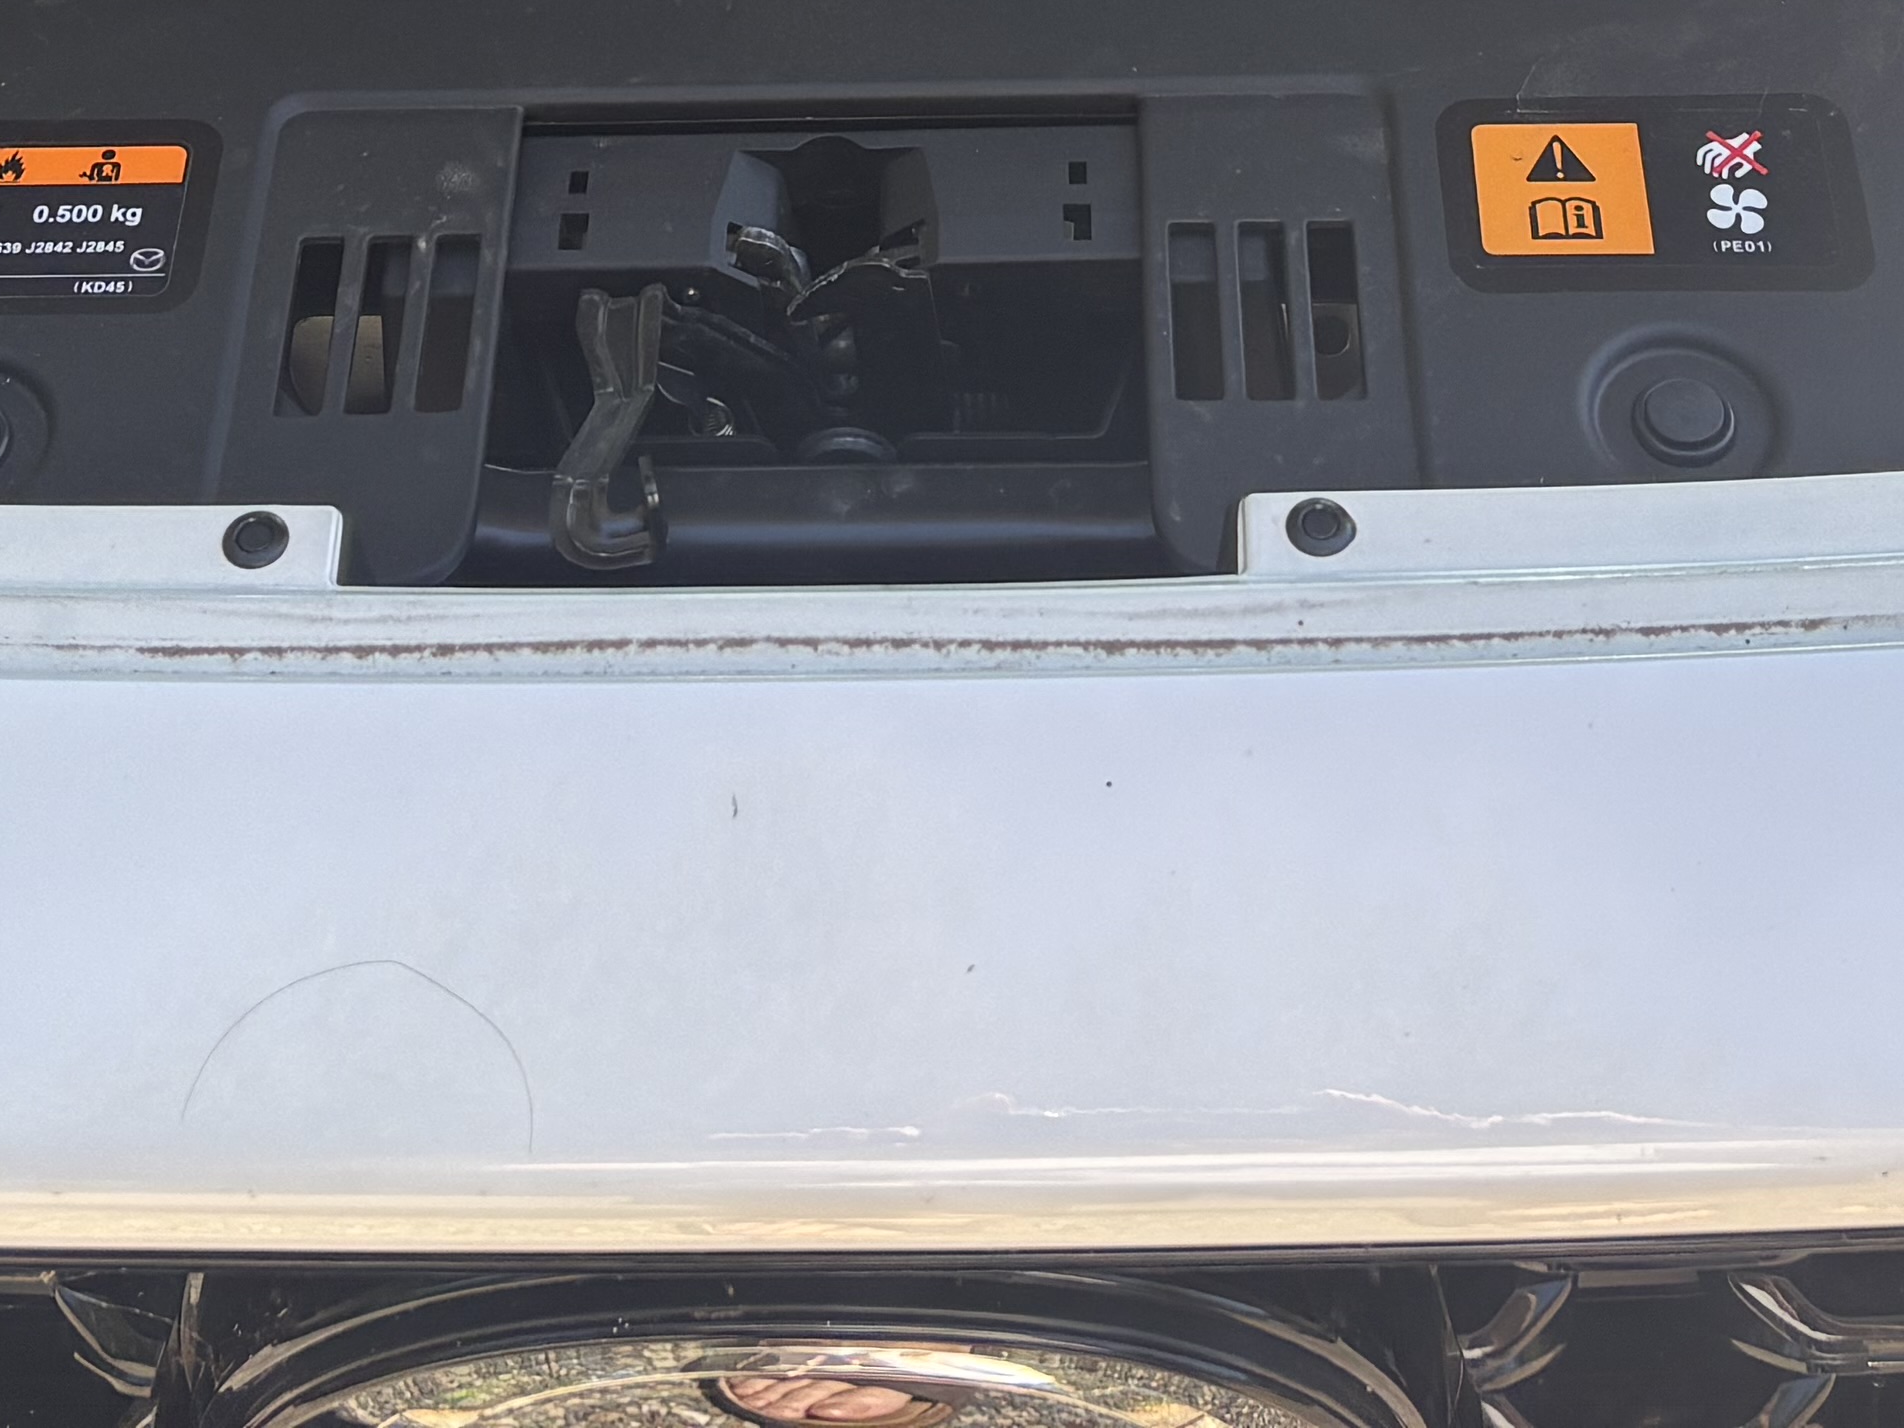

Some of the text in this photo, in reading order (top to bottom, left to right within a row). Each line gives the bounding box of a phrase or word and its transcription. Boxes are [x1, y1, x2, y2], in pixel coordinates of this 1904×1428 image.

[32, 204, 103, 224] 0.500
[110, 203, 143, 227] kg
[25, 241, 73, 254] J2842
[76, 240, 125, 254] J2845
[1713, 240, 1773, 253] (PE01)
[73, 280, 133, 294] (KD45)
